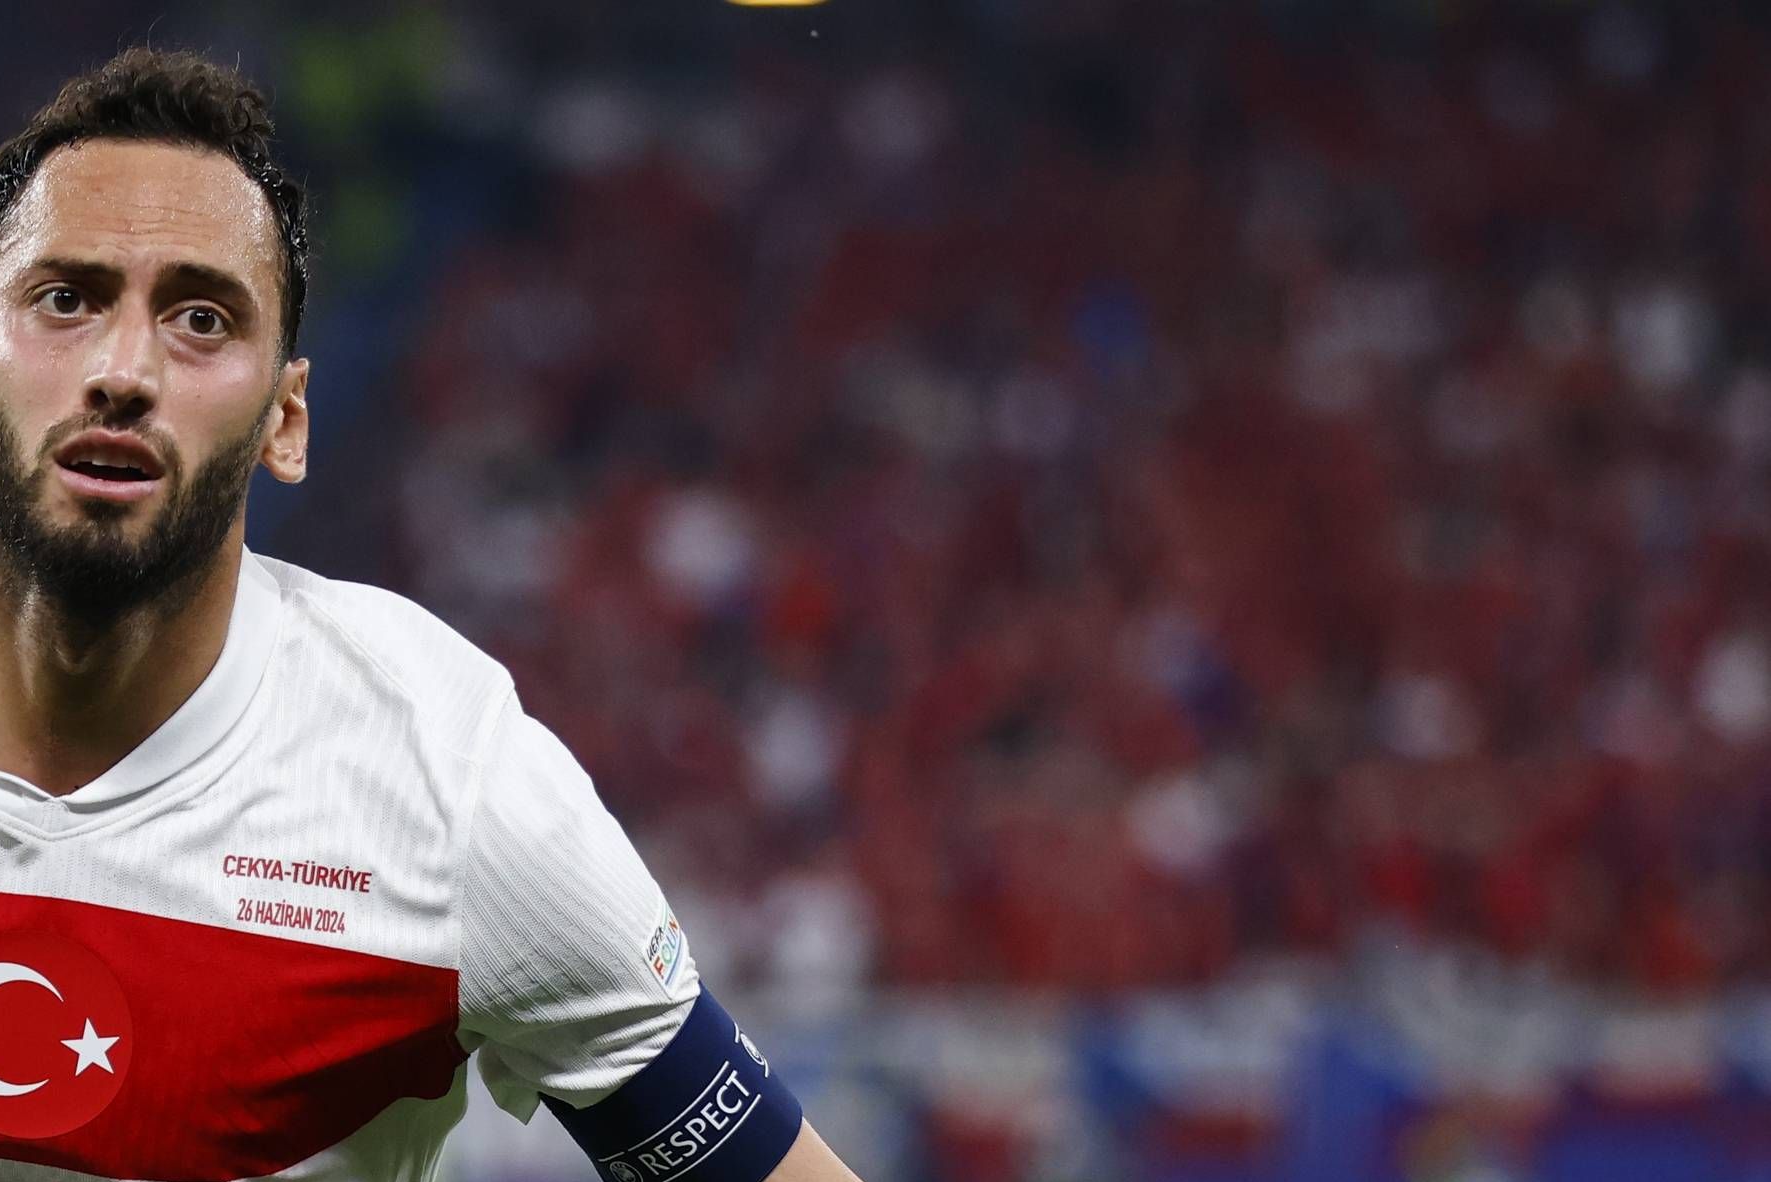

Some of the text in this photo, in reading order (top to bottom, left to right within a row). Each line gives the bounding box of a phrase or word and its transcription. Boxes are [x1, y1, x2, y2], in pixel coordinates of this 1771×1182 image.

[222, 855, 372, 893] ÇEKYA-TÜRKİYE
[236, 898, 346, 934] 26 HAZİRAN 2024
[638, 1070, 750, 1176] RESPECT
